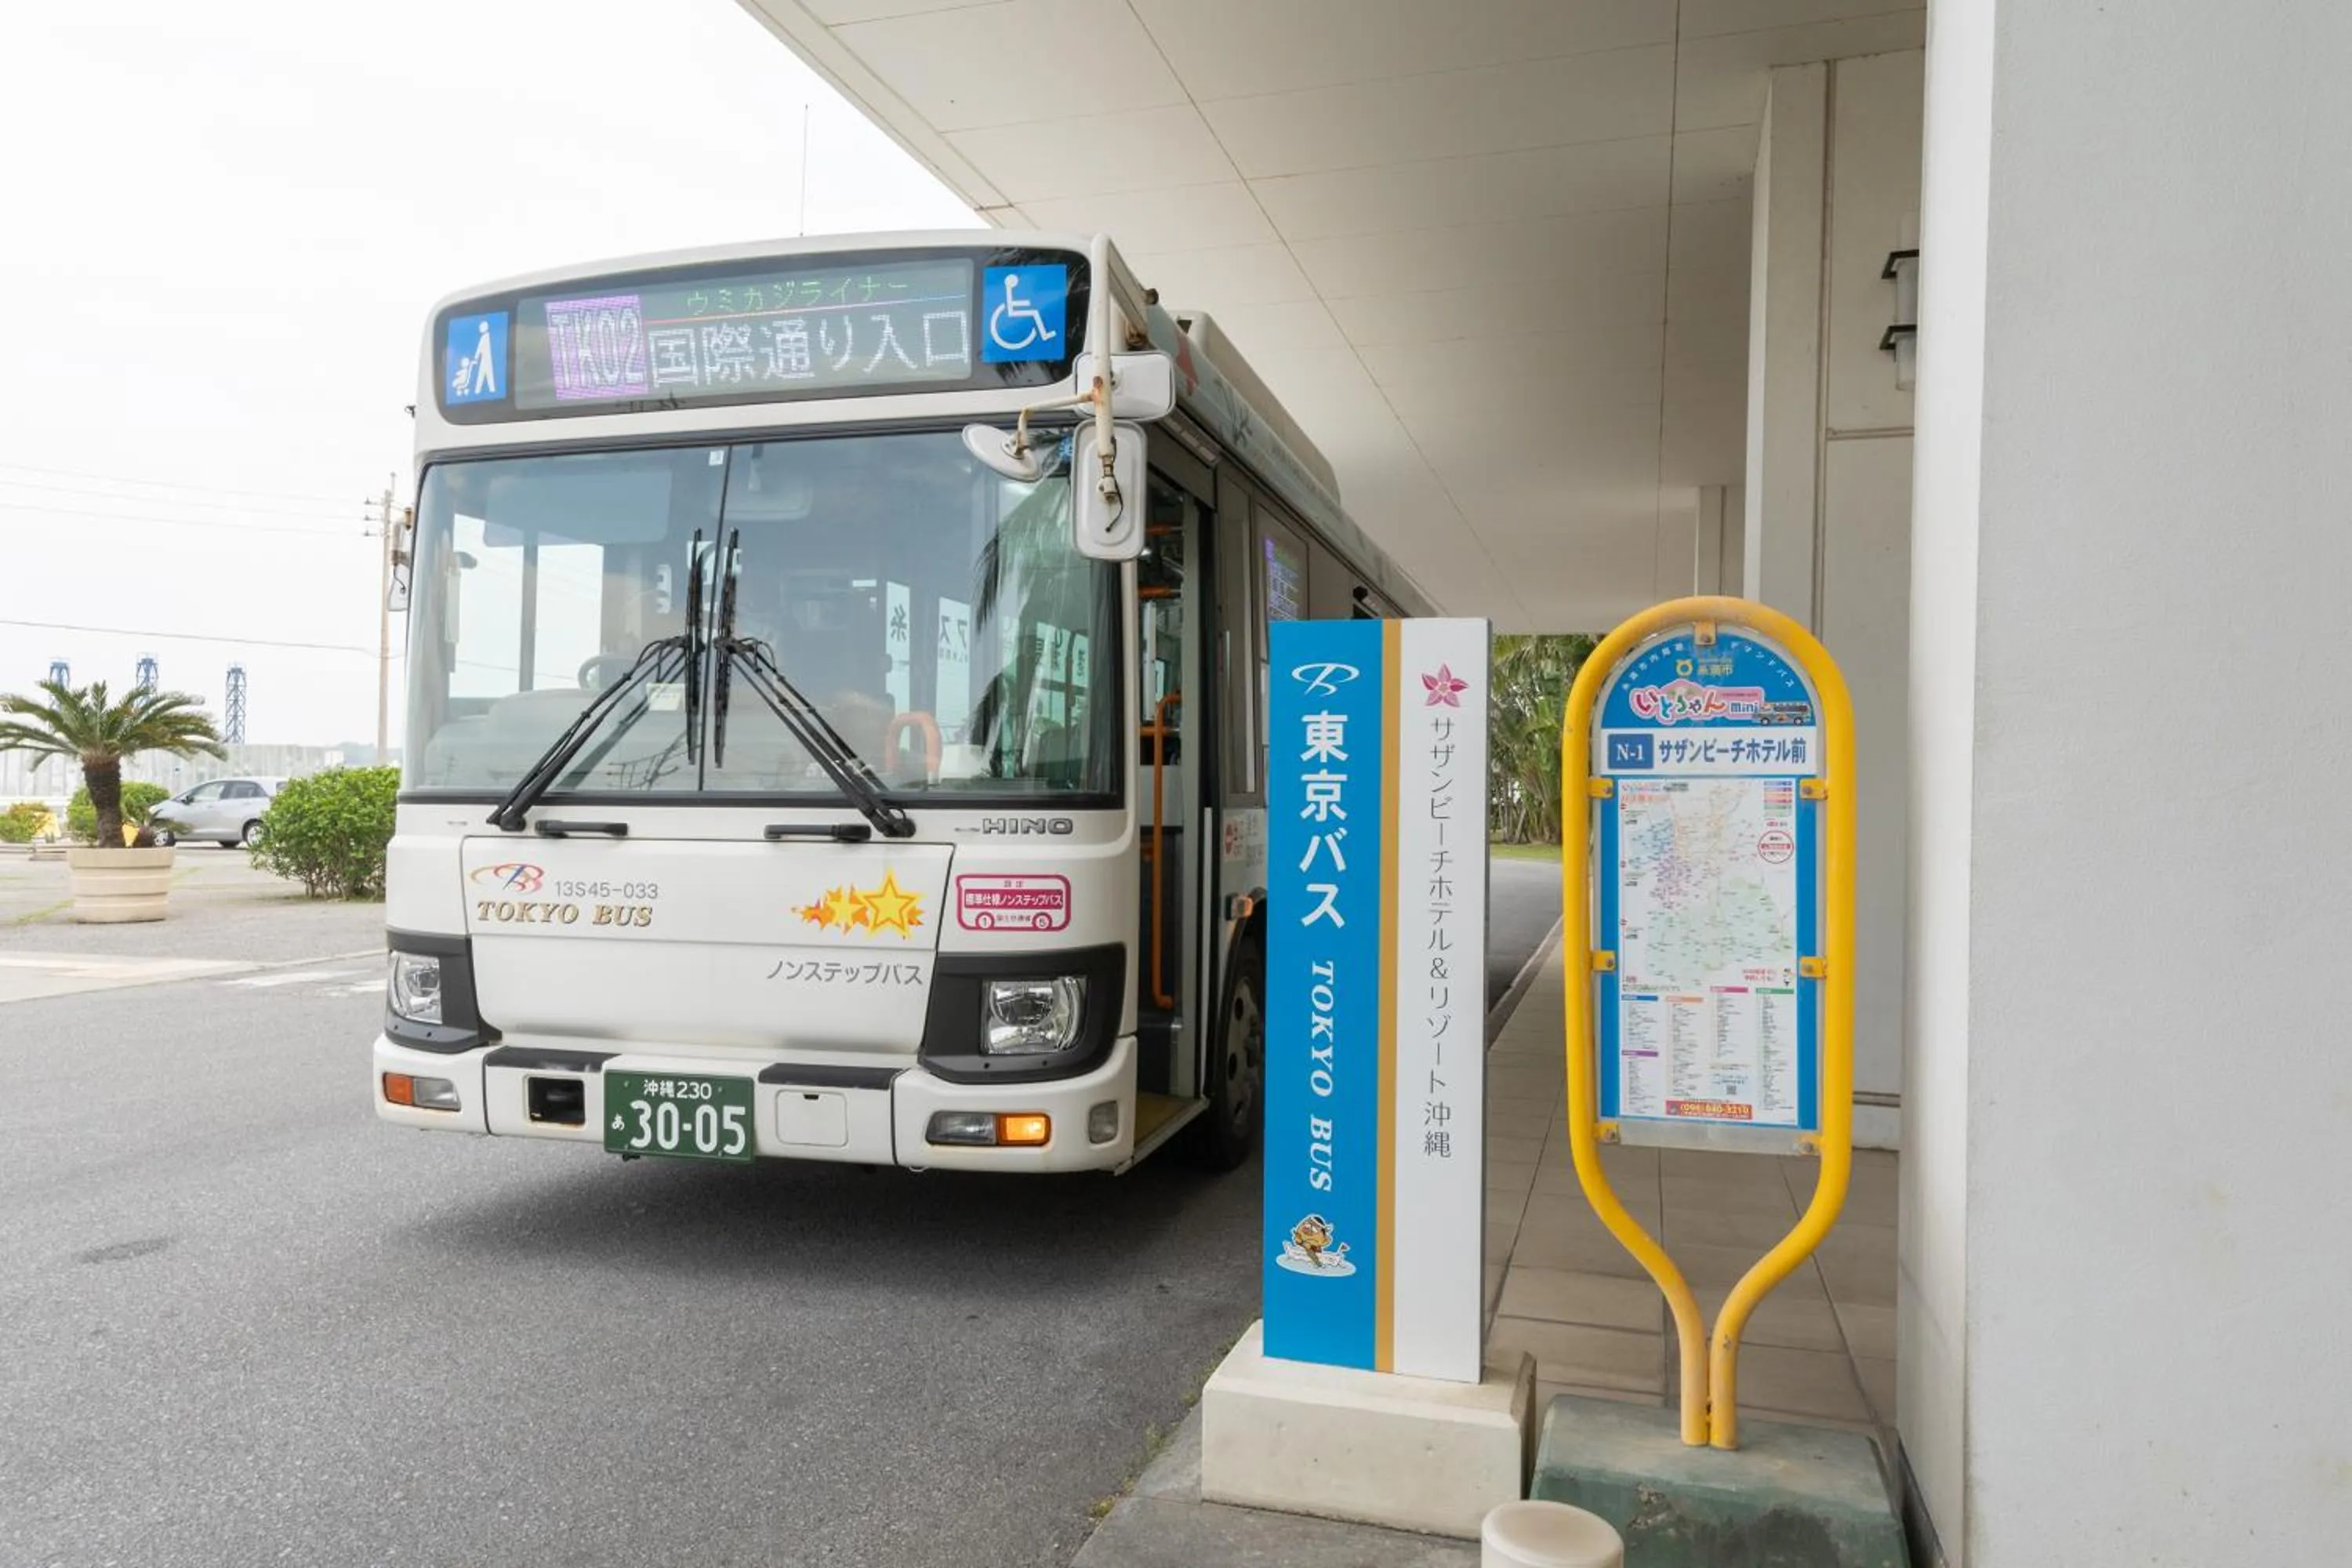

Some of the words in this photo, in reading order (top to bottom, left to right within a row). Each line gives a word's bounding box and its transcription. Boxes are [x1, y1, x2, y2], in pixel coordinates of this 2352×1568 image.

[686, 278, 908, 315] ウミカジライナー
[550, 309, 645, 389] TK02
[648, 310, 968, 389] 国際通り入口
[1617, 743, 1643, 761] N-1
[1659, 737, 1806, 764] サザンビーチホテル前
[982, 818, 1073, 835] HINO
[1299, 710, 1349, 928] 東京バス
[554, 880, 659, 900] 13S45-033
[477, 901, 579, 925] TOKYO
[592, 904, 653, 927] BUS
[767, 960, 924, 985] ノンステップバス
[1310, 960, 1334, 1098] TOKYO
[611, 1112, 626, 1131] あ
[630, 1099, 746, 1156] 30-05
[1308, 1113, 1333, 1192] BUS
